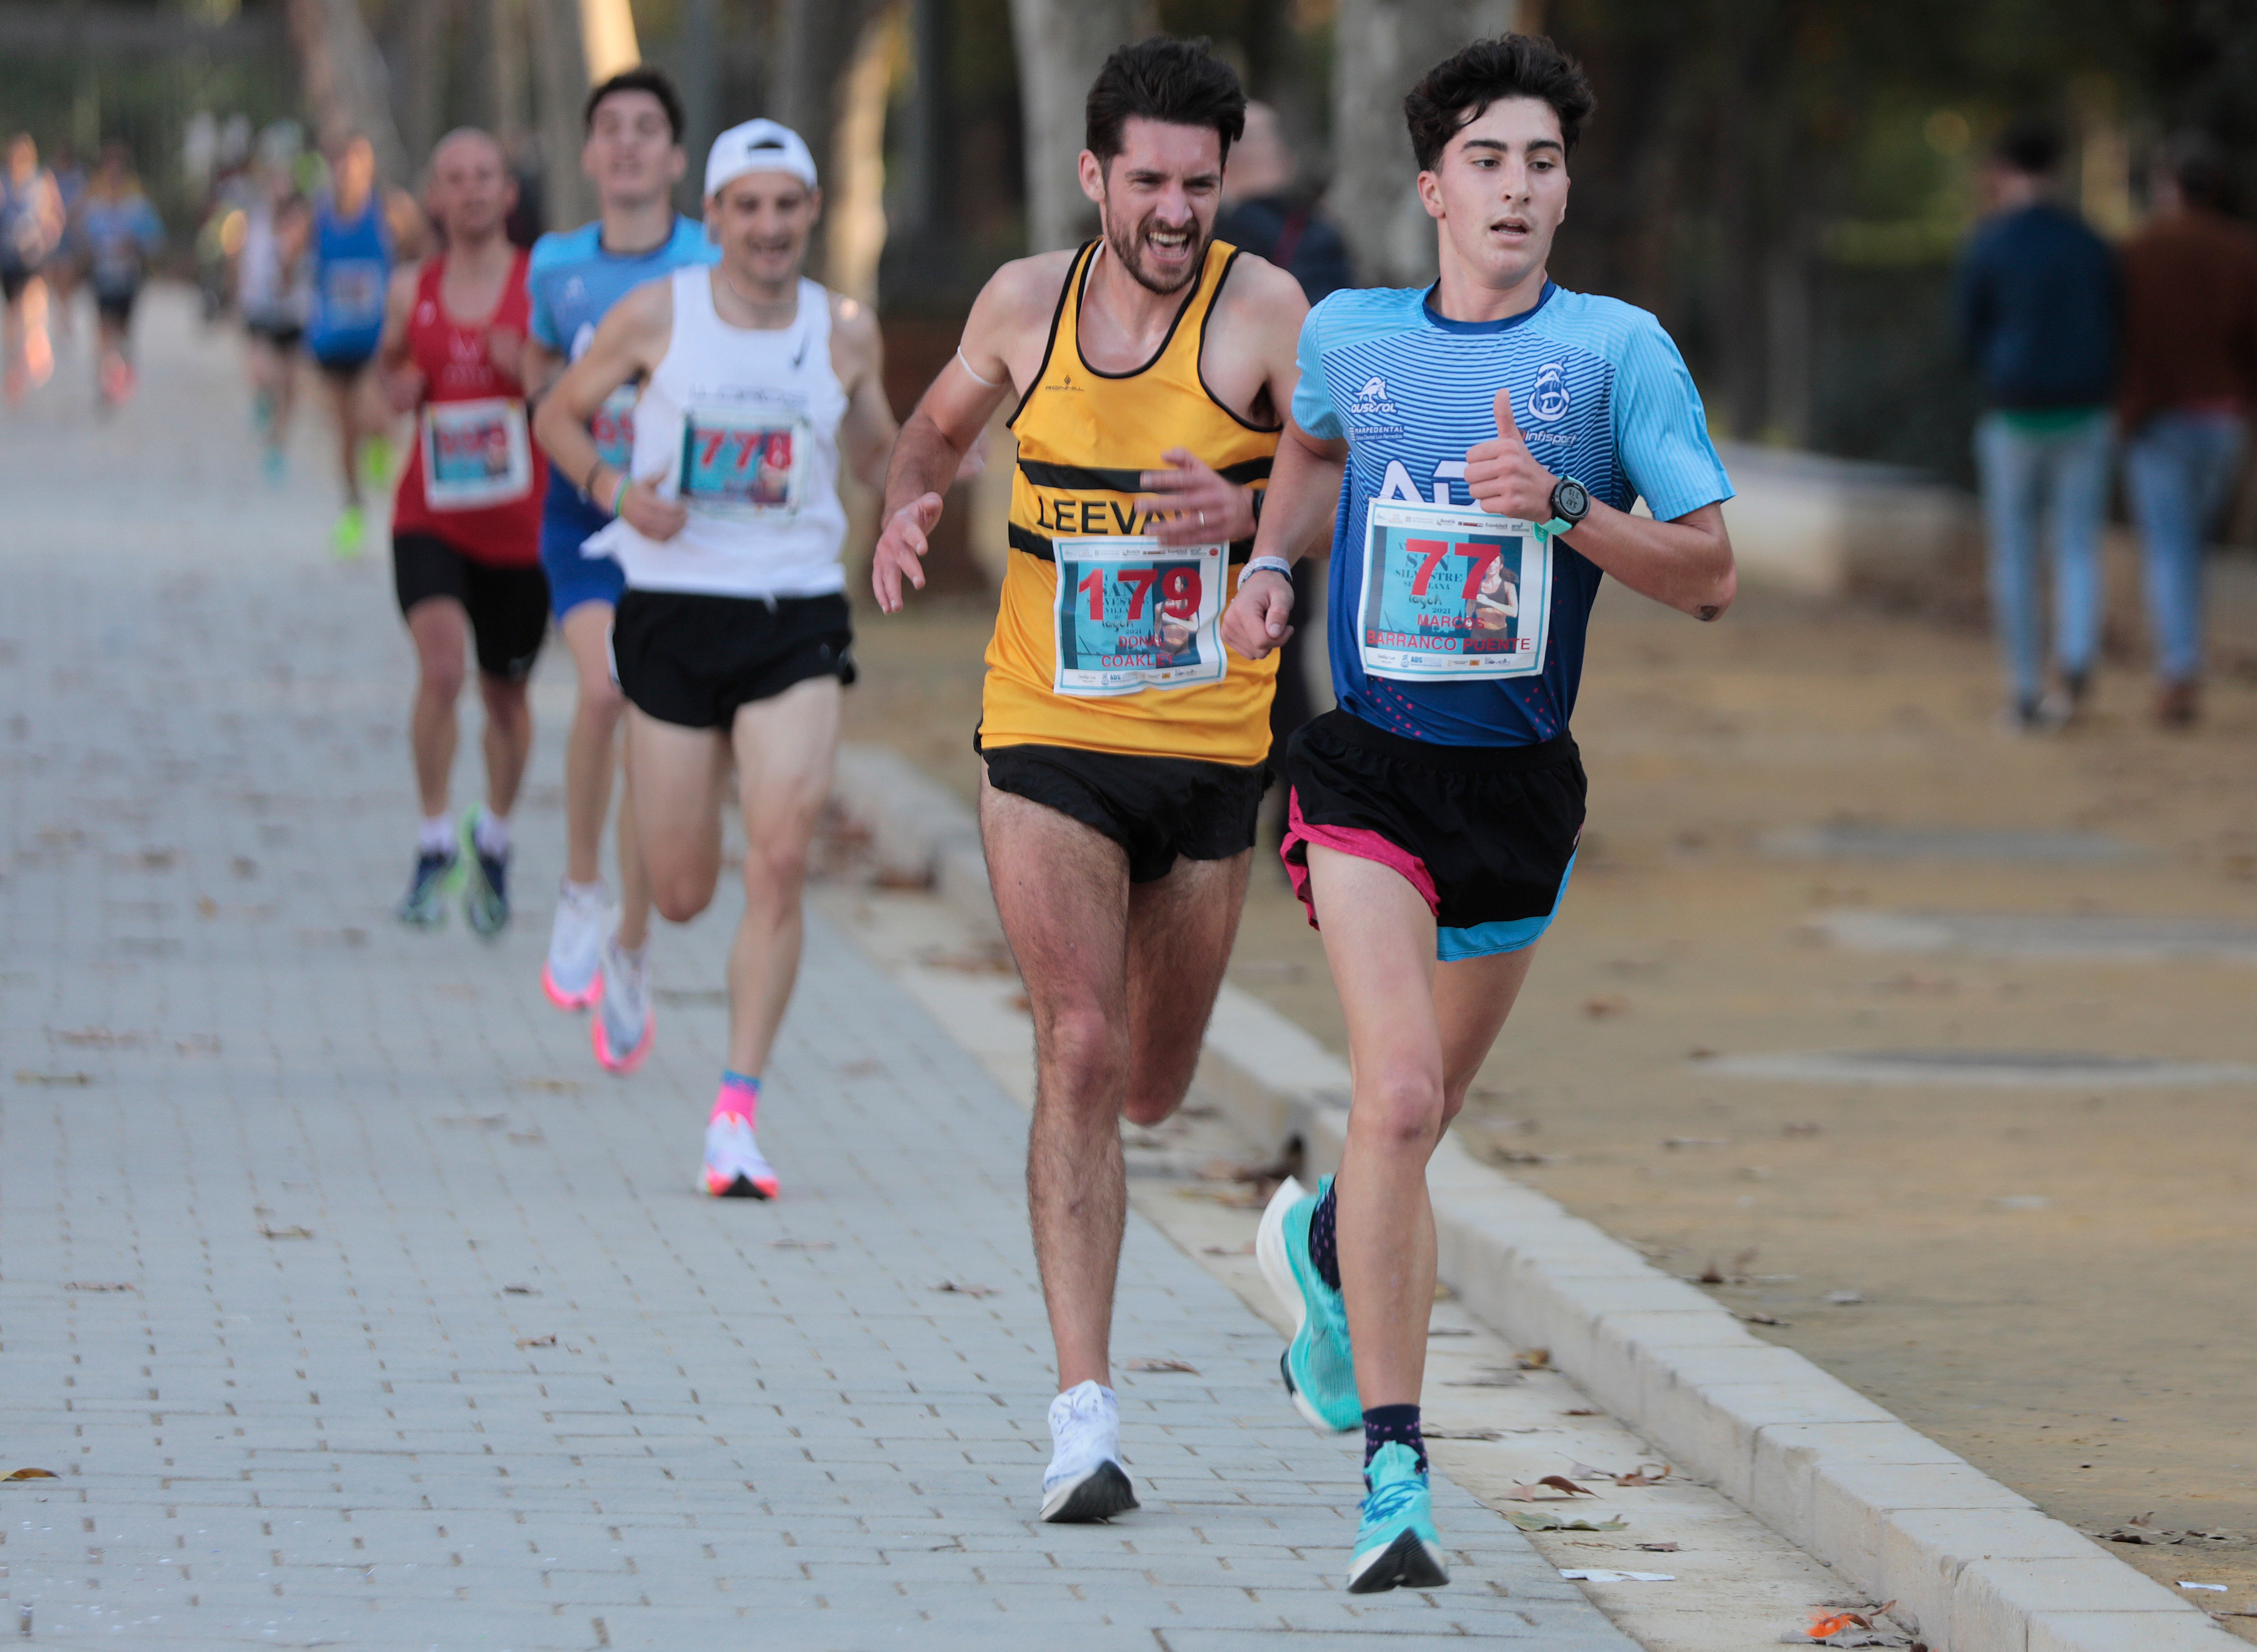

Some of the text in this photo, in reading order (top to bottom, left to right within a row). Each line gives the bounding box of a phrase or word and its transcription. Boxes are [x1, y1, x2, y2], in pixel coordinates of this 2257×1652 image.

[1351, 403, 1397, 414] austral
[1524, 430, 1577, 445] infisport
[694, 428, 793, 470] 778
[1405, 538, 1501, 600] 77
[1078, 567, 1203, 621] 179
[1417, 613, 1485, 630] MARCOS
[1118, 635, 1166, 647] DONAL
[1365, 630, 1531, 651] BARRANCO PUENTE
[1101, 653, 1174, 667] COAKLEY
